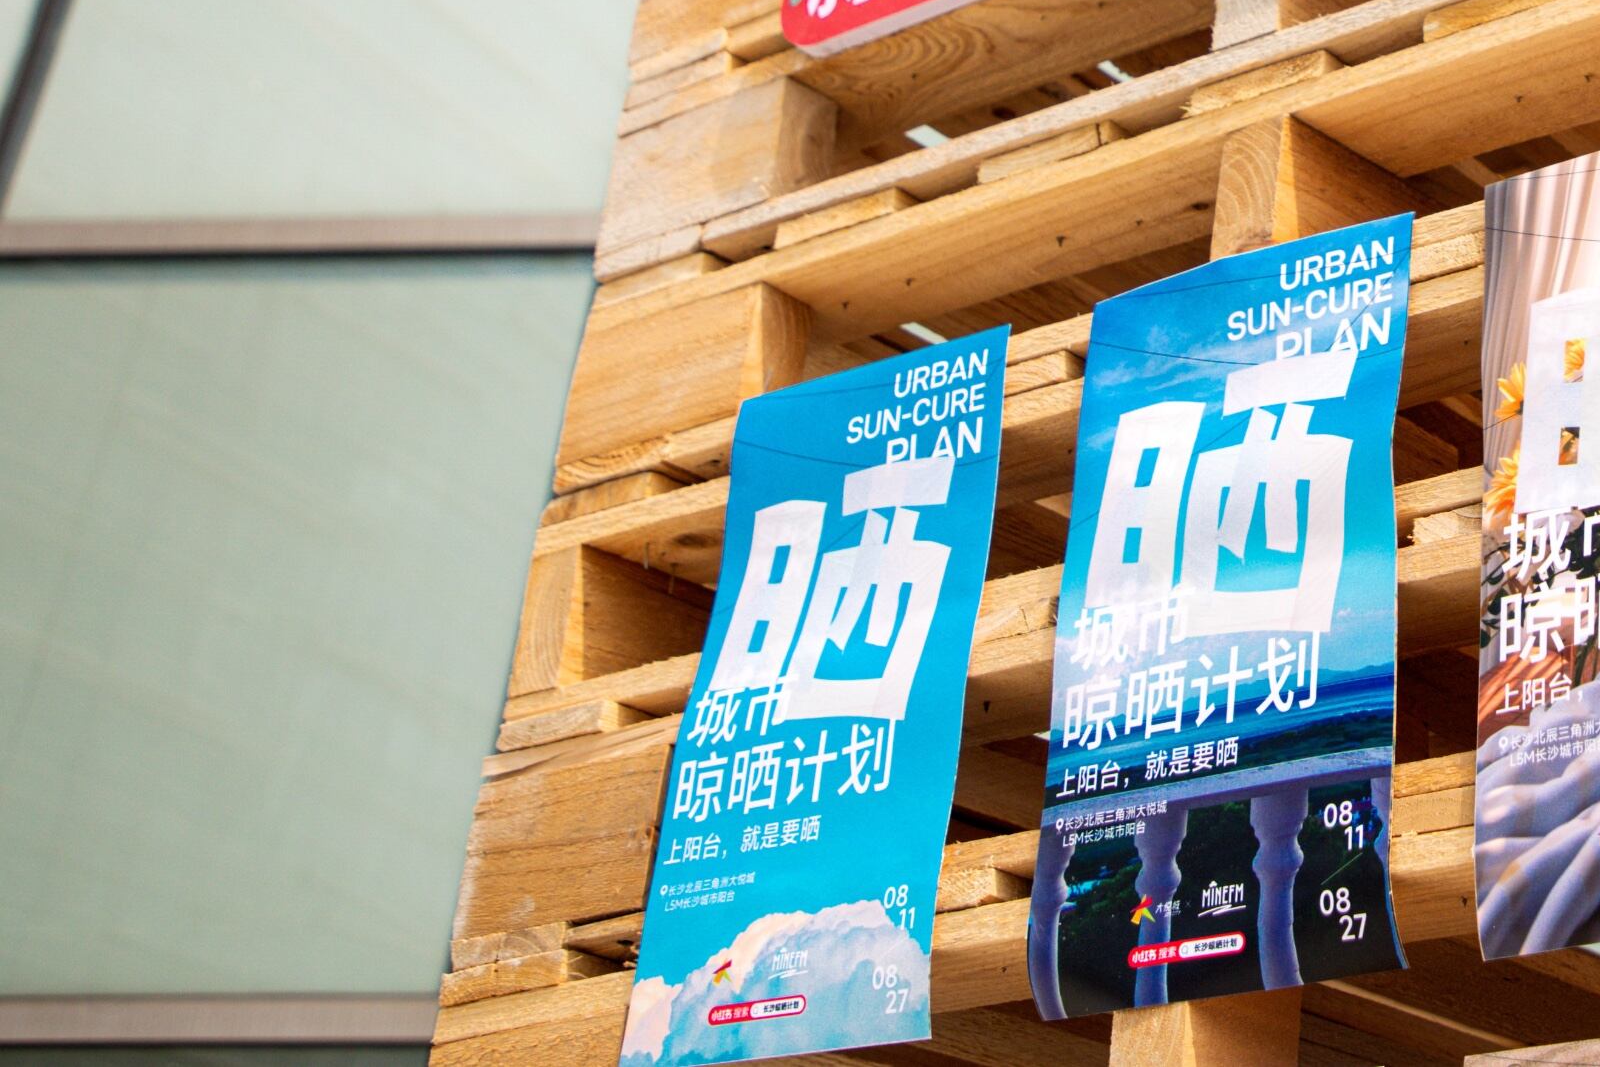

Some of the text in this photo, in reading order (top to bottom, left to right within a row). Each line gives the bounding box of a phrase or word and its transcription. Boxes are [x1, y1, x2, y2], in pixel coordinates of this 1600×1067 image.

[1278, 236, 1395, 291] URBAN
[1226, 272, 1395, 341] SUN-CURE
[893, 348, 989, 398] URBAN
[846, 383, 986, 445] SUN-CURE
[1071, 586, 1197, 670] 城市
[1062, 629, 1320, 751] 晾晒计划
[687, 675, 799, 749] 城市
[672, 718, 896, 823] 晾晒计划
[1064, 800, 1168, 831] 长沙北辰三角洲大悦城
[1323, 799, 1354, 829] 08
[1343, 826, 1365, 852] 11
[883, 884, 910, 909] 08
[1319, 887, 1352, 918] 08
[899, 906, 916, 931] 11
[1340, 912, 1368, 942] 27
[872, 964, 898, 989] 08
[885, 989, 910, 1015] 27
